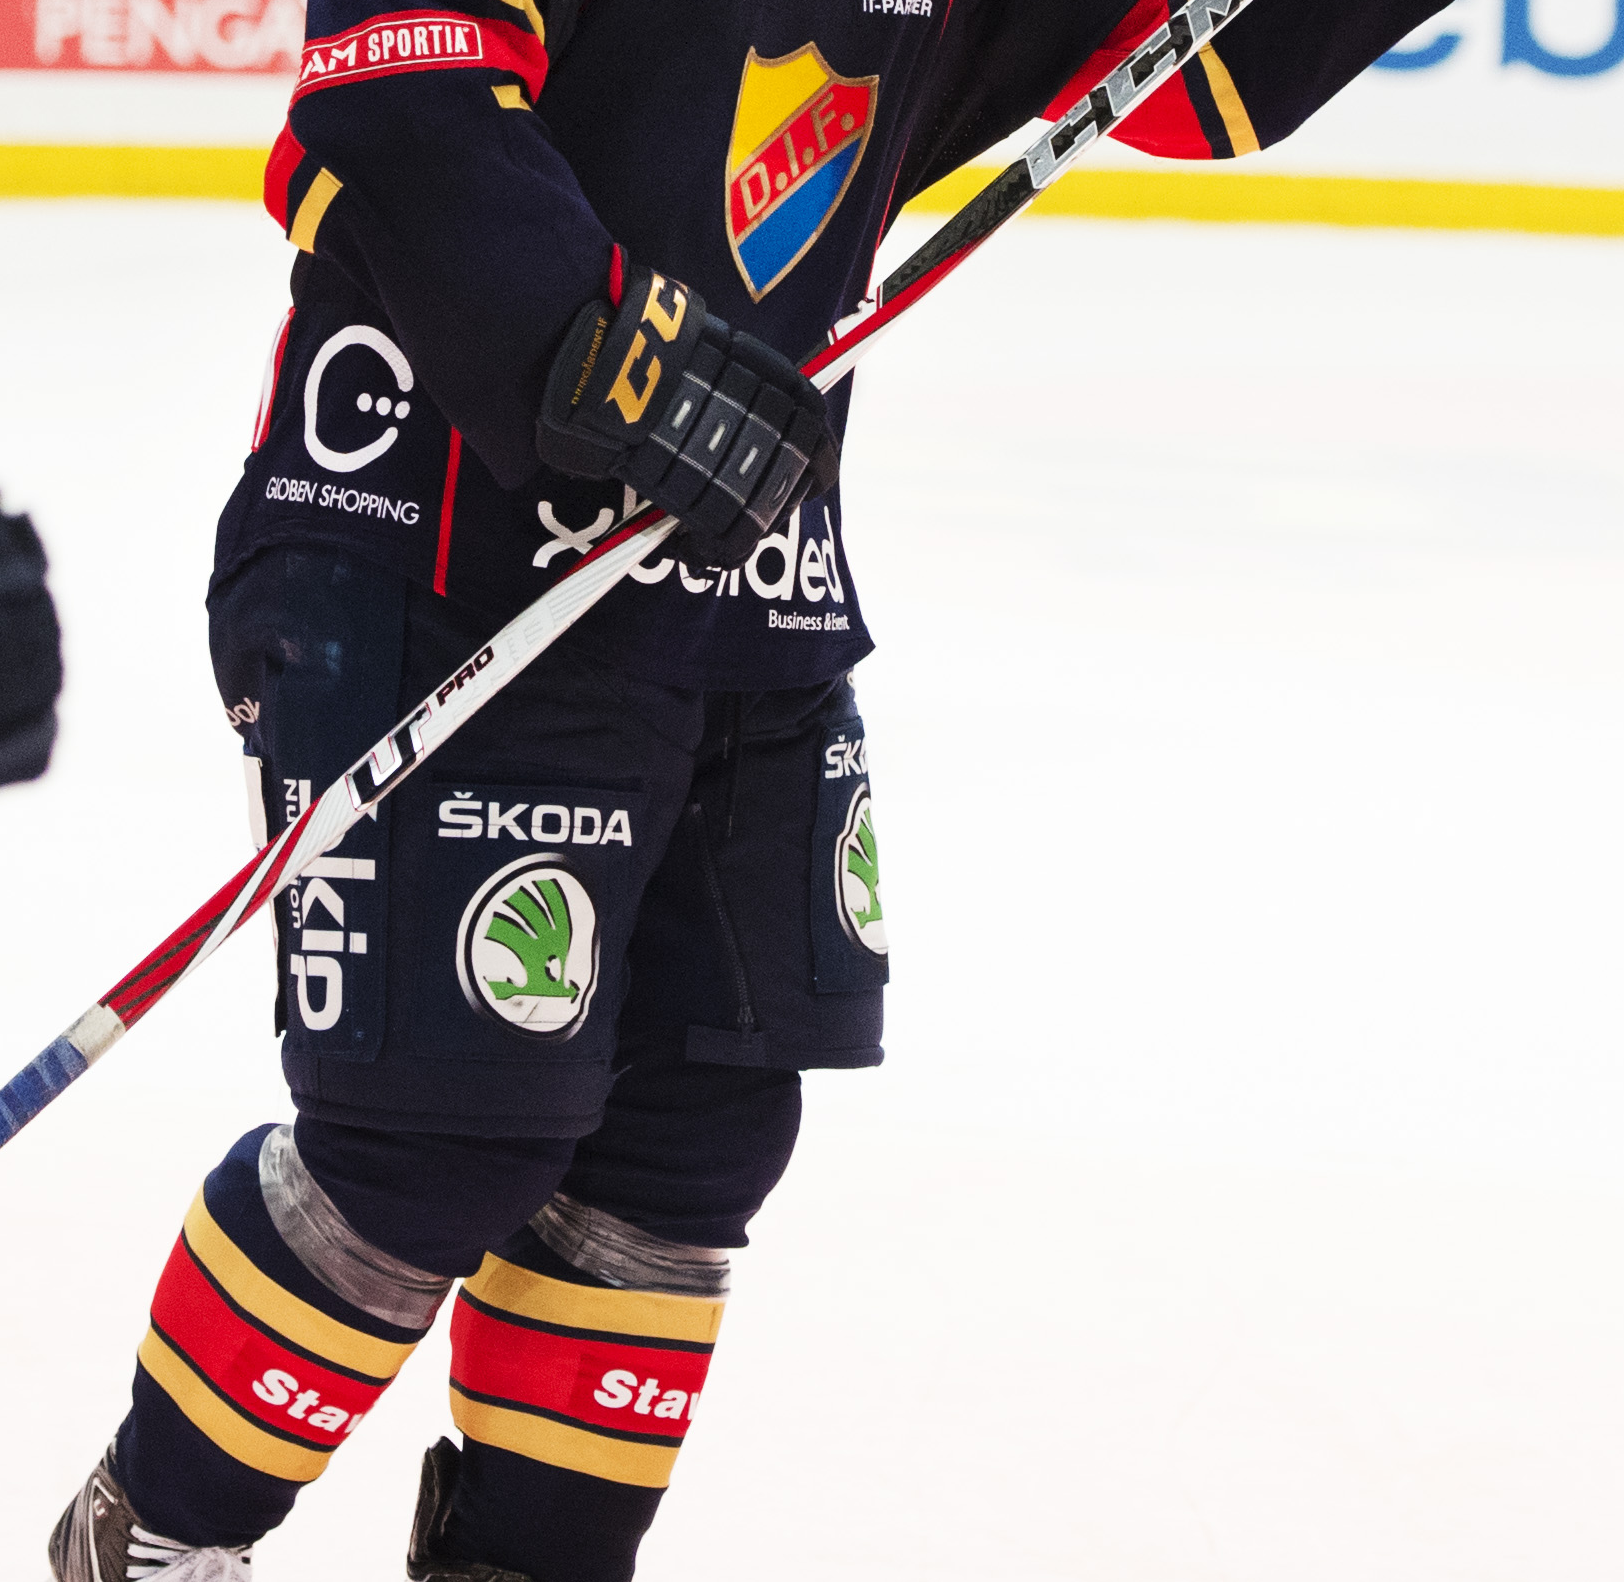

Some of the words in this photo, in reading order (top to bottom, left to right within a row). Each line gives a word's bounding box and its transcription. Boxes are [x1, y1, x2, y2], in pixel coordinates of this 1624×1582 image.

[367, 24, 470, 64] SPORTIA
[739, 89, 856, 221] D.I.F.
[604, 273, 689, 424] CC
[266, 476, 317, 504] GLOBEN
[318, 484, 420, 525] SHOPPING
[768, 609, 822, 630] Business
[823, 612, 832, 631] &
[434, 645, 495, 708] PRO
[437, 791, 632, 846] ŠKODA
